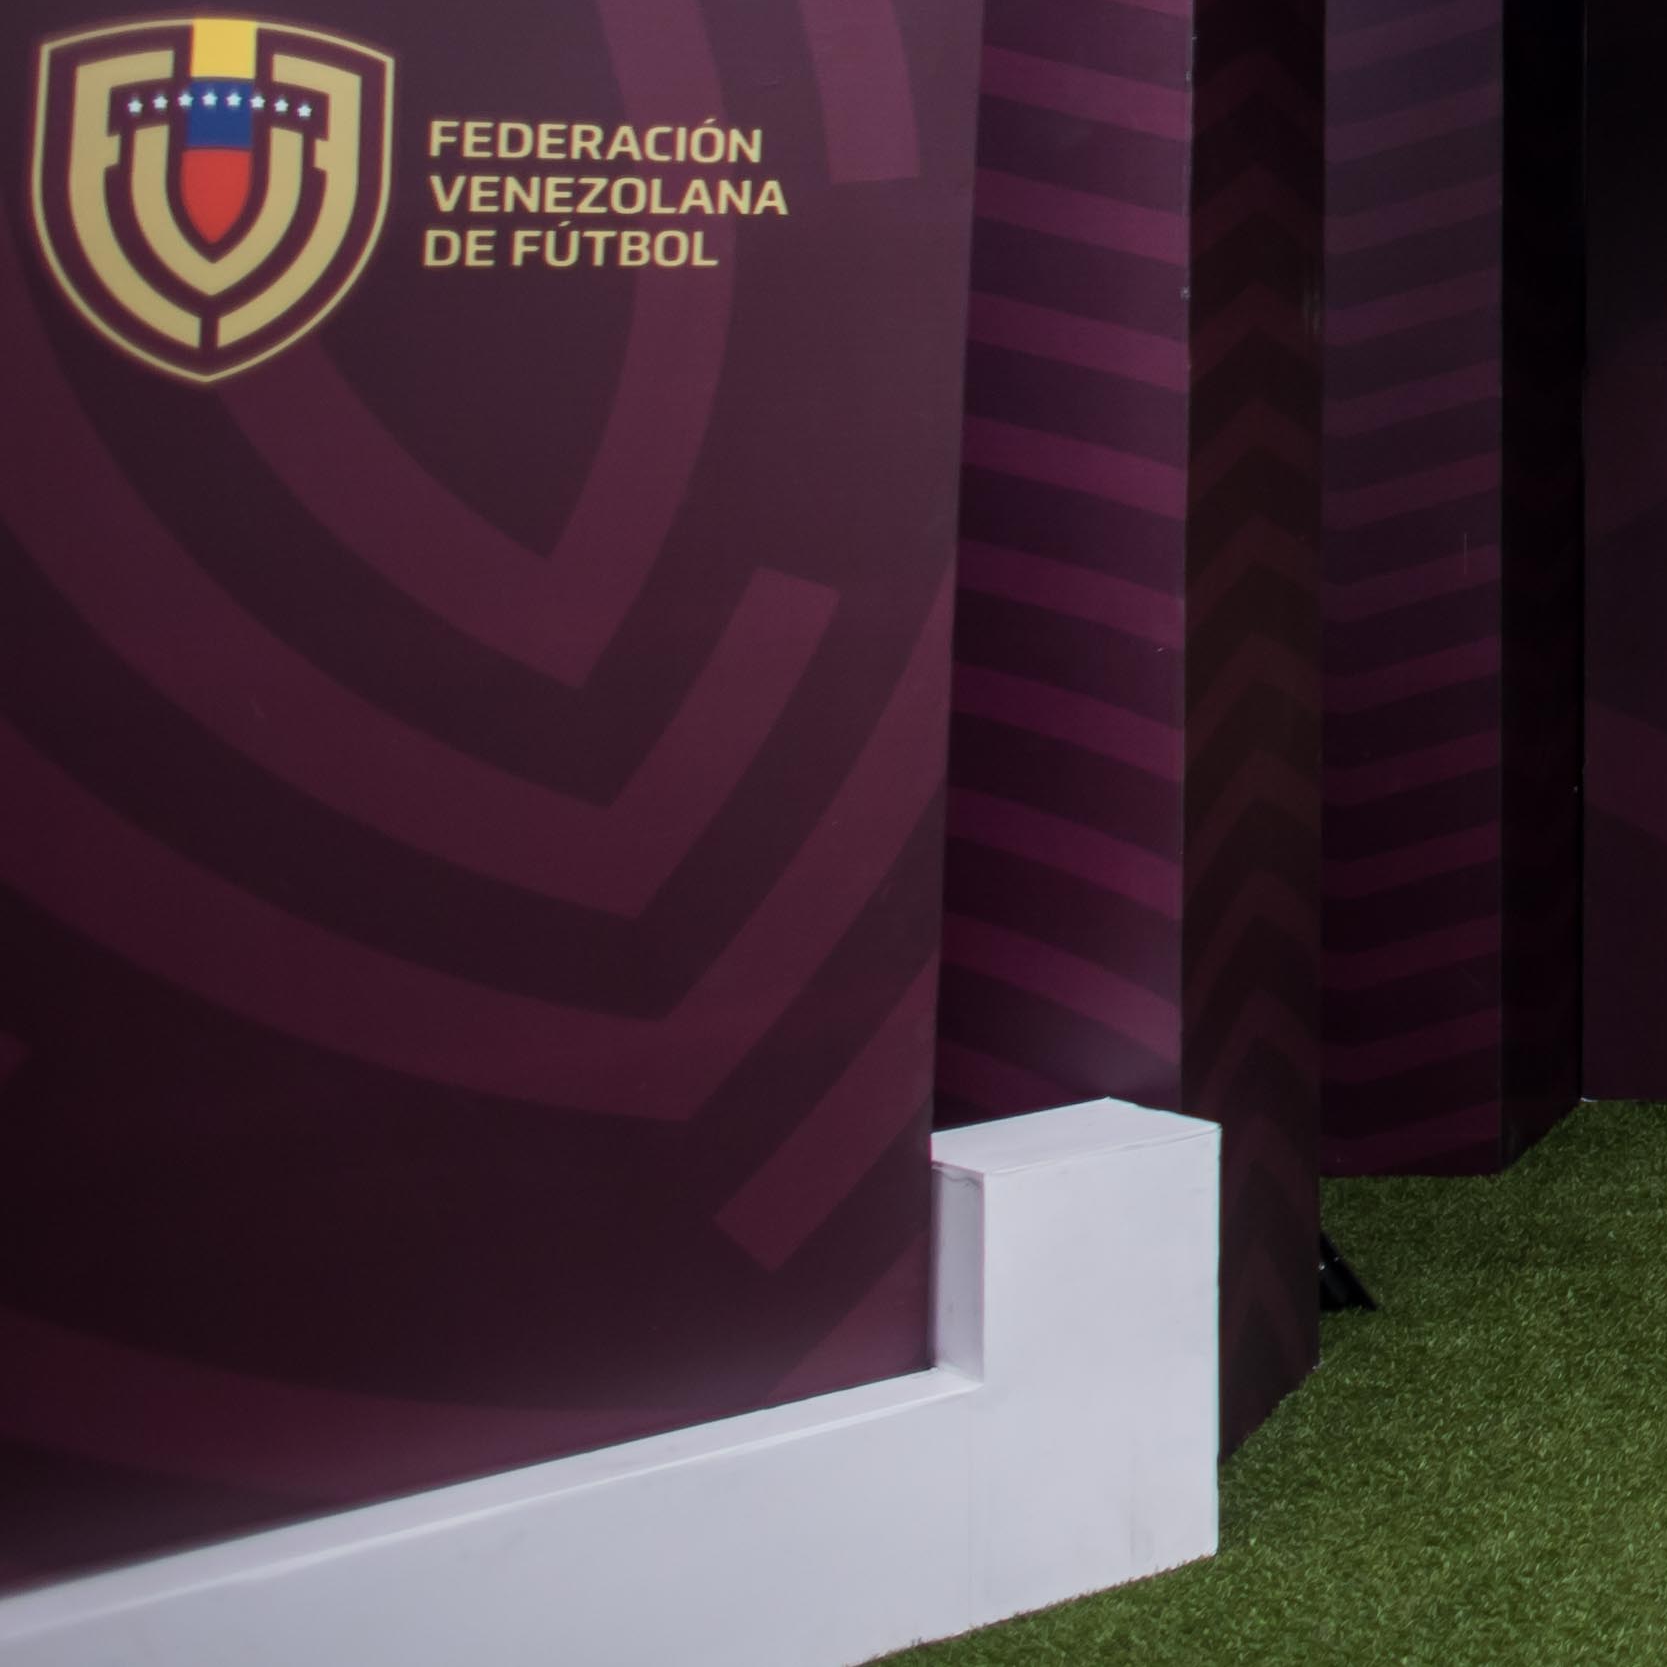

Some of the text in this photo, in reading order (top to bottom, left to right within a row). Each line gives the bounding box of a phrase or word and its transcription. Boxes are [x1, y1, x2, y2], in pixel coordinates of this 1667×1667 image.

[429, 119, 763, 164] FEDERACIÓN
[430, 174, 789, 216] VENEZOLANA
[422, 220, 719, 269] DE FÚTBOL
